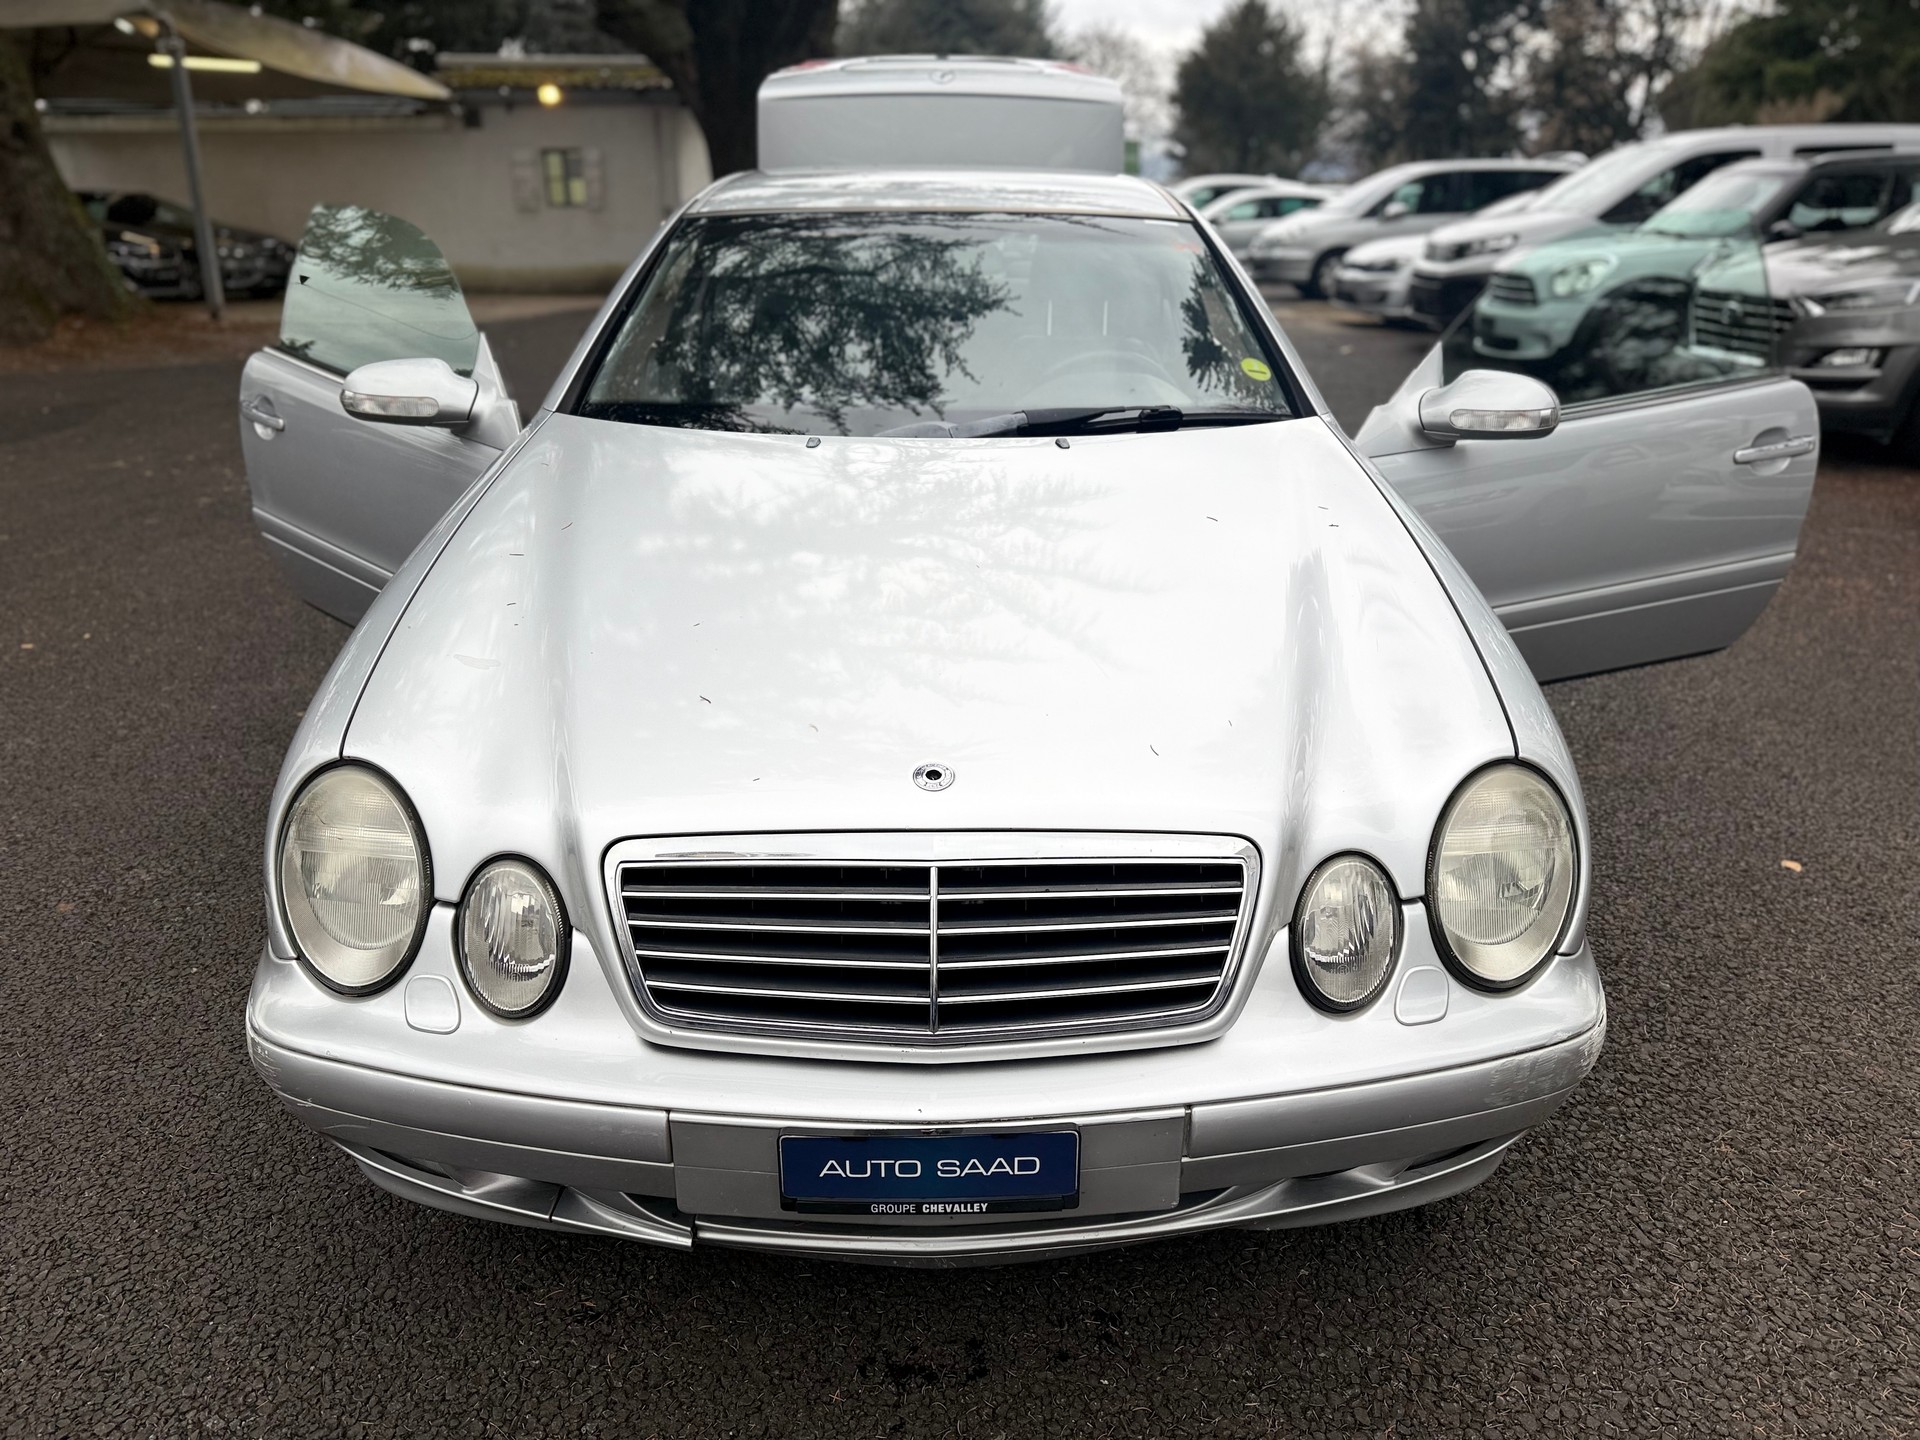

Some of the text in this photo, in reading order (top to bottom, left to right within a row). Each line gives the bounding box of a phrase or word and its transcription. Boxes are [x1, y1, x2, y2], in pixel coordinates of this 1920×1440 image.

[819, 1156, 1040, 1178] AUTO SAAD
[870, 1202, 988, 1213] GROUPE CHEVALLEY
